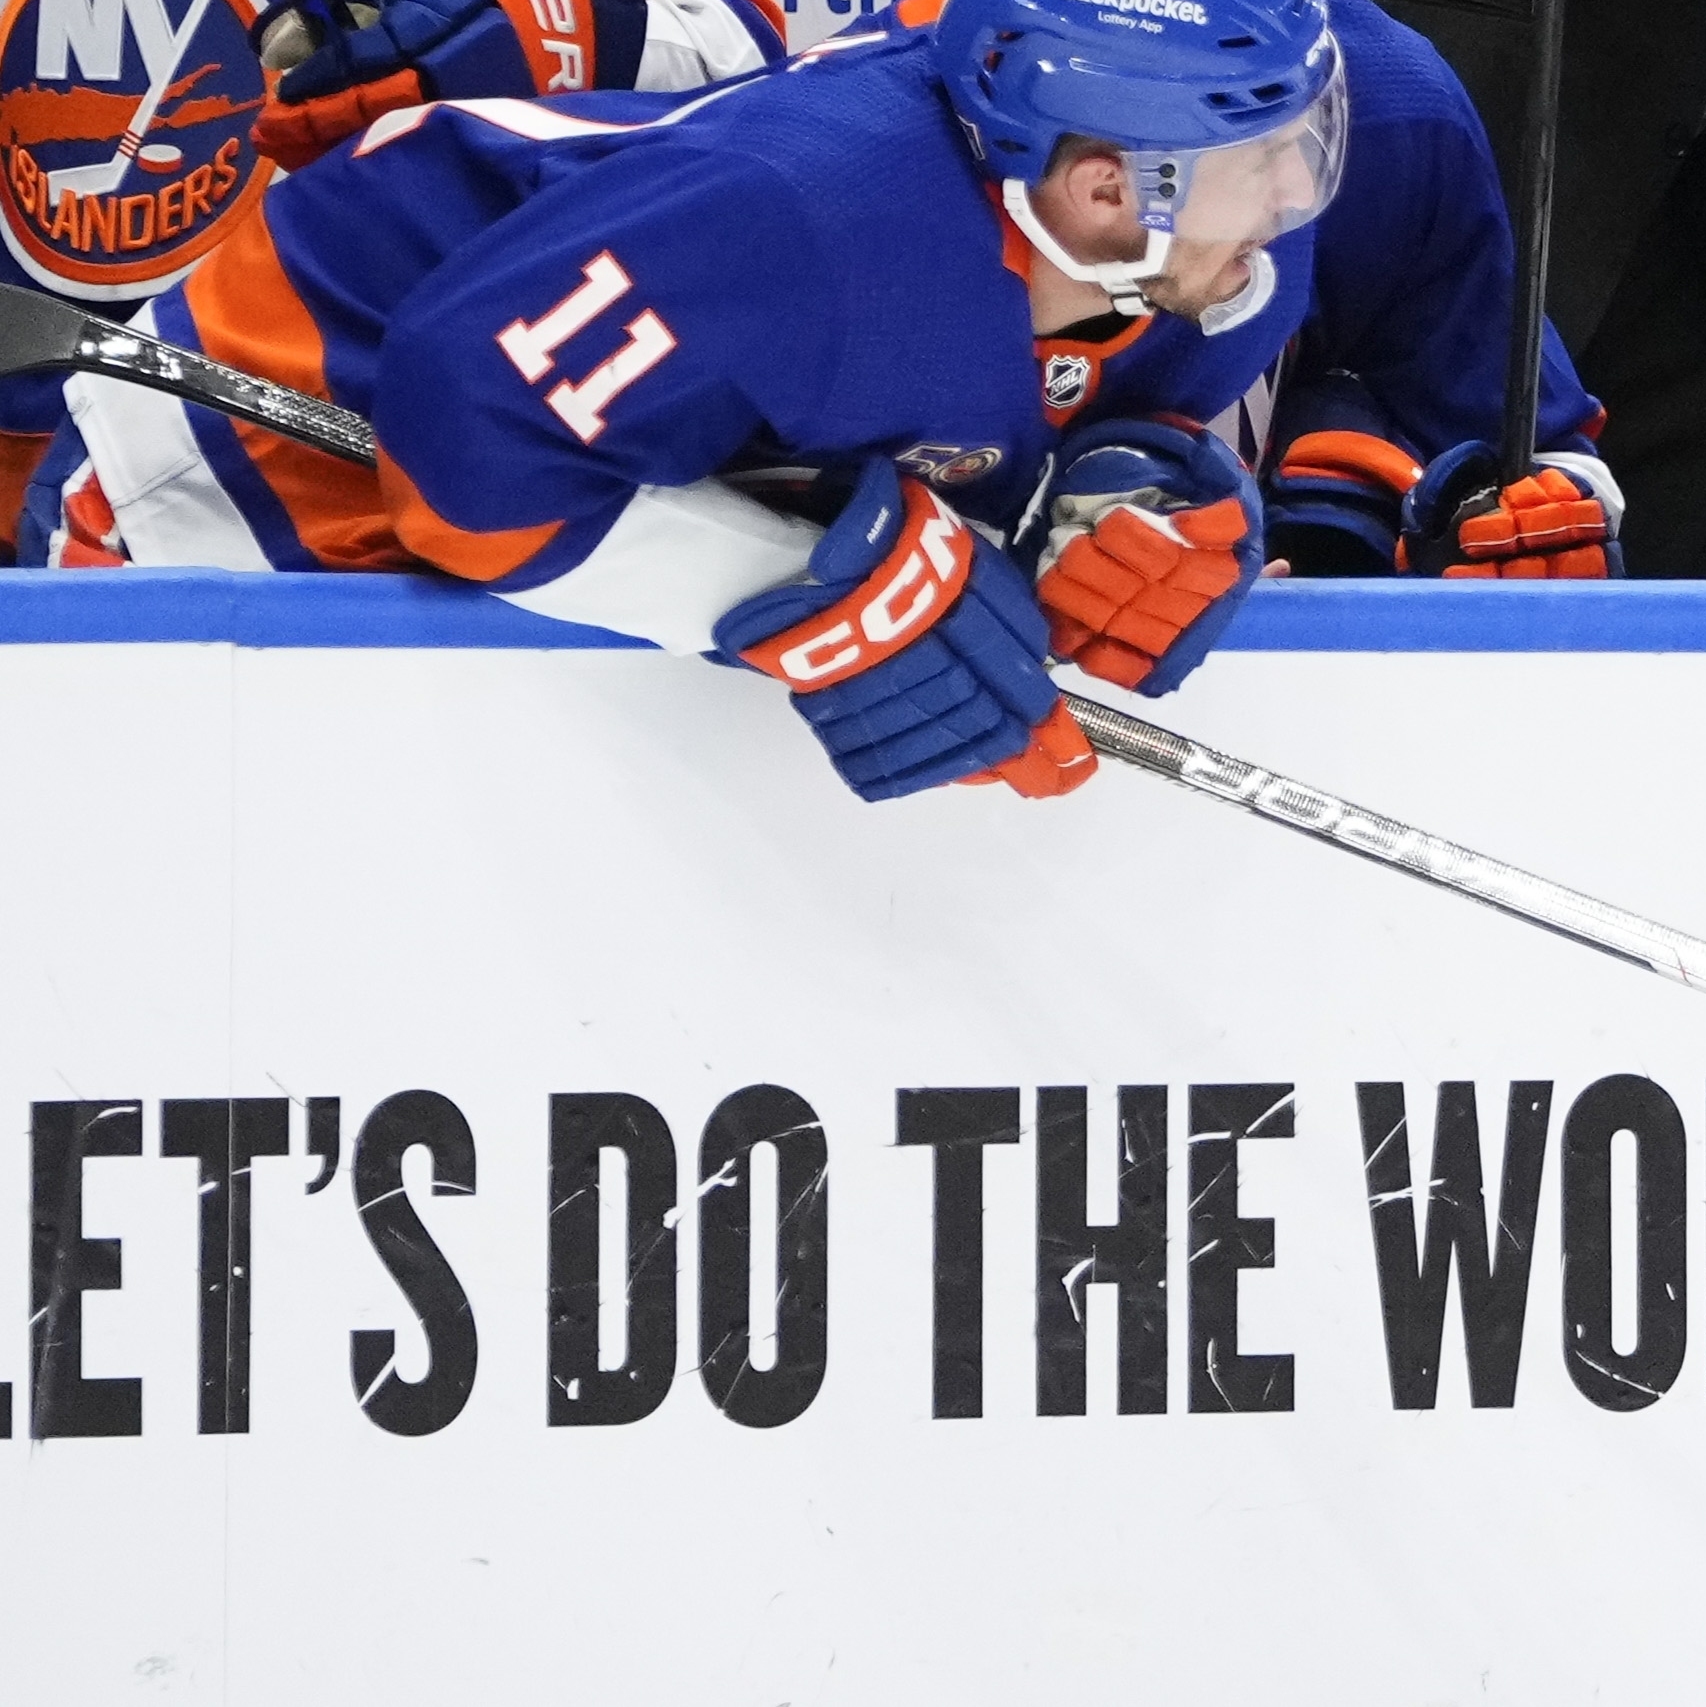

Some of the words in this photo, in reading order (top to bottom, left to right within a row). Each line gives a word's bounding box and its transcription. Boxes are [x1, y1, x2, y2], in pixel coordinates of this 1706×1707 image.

[1097, 10, 1138, 29] Lottery
[1138, 17, 1164, 35] App
[9, 136, 242, 254] ISLANDERS
[495, 249, 678, 446] 11
[1049, 370, 1080, 397] NHL
[779, 502, 974, 689] CCM
[0, 1088, 479, 1439] ET’S
[545, 1087, 831, 1431] DO
[893, 1082, 1297, 1422] THE
